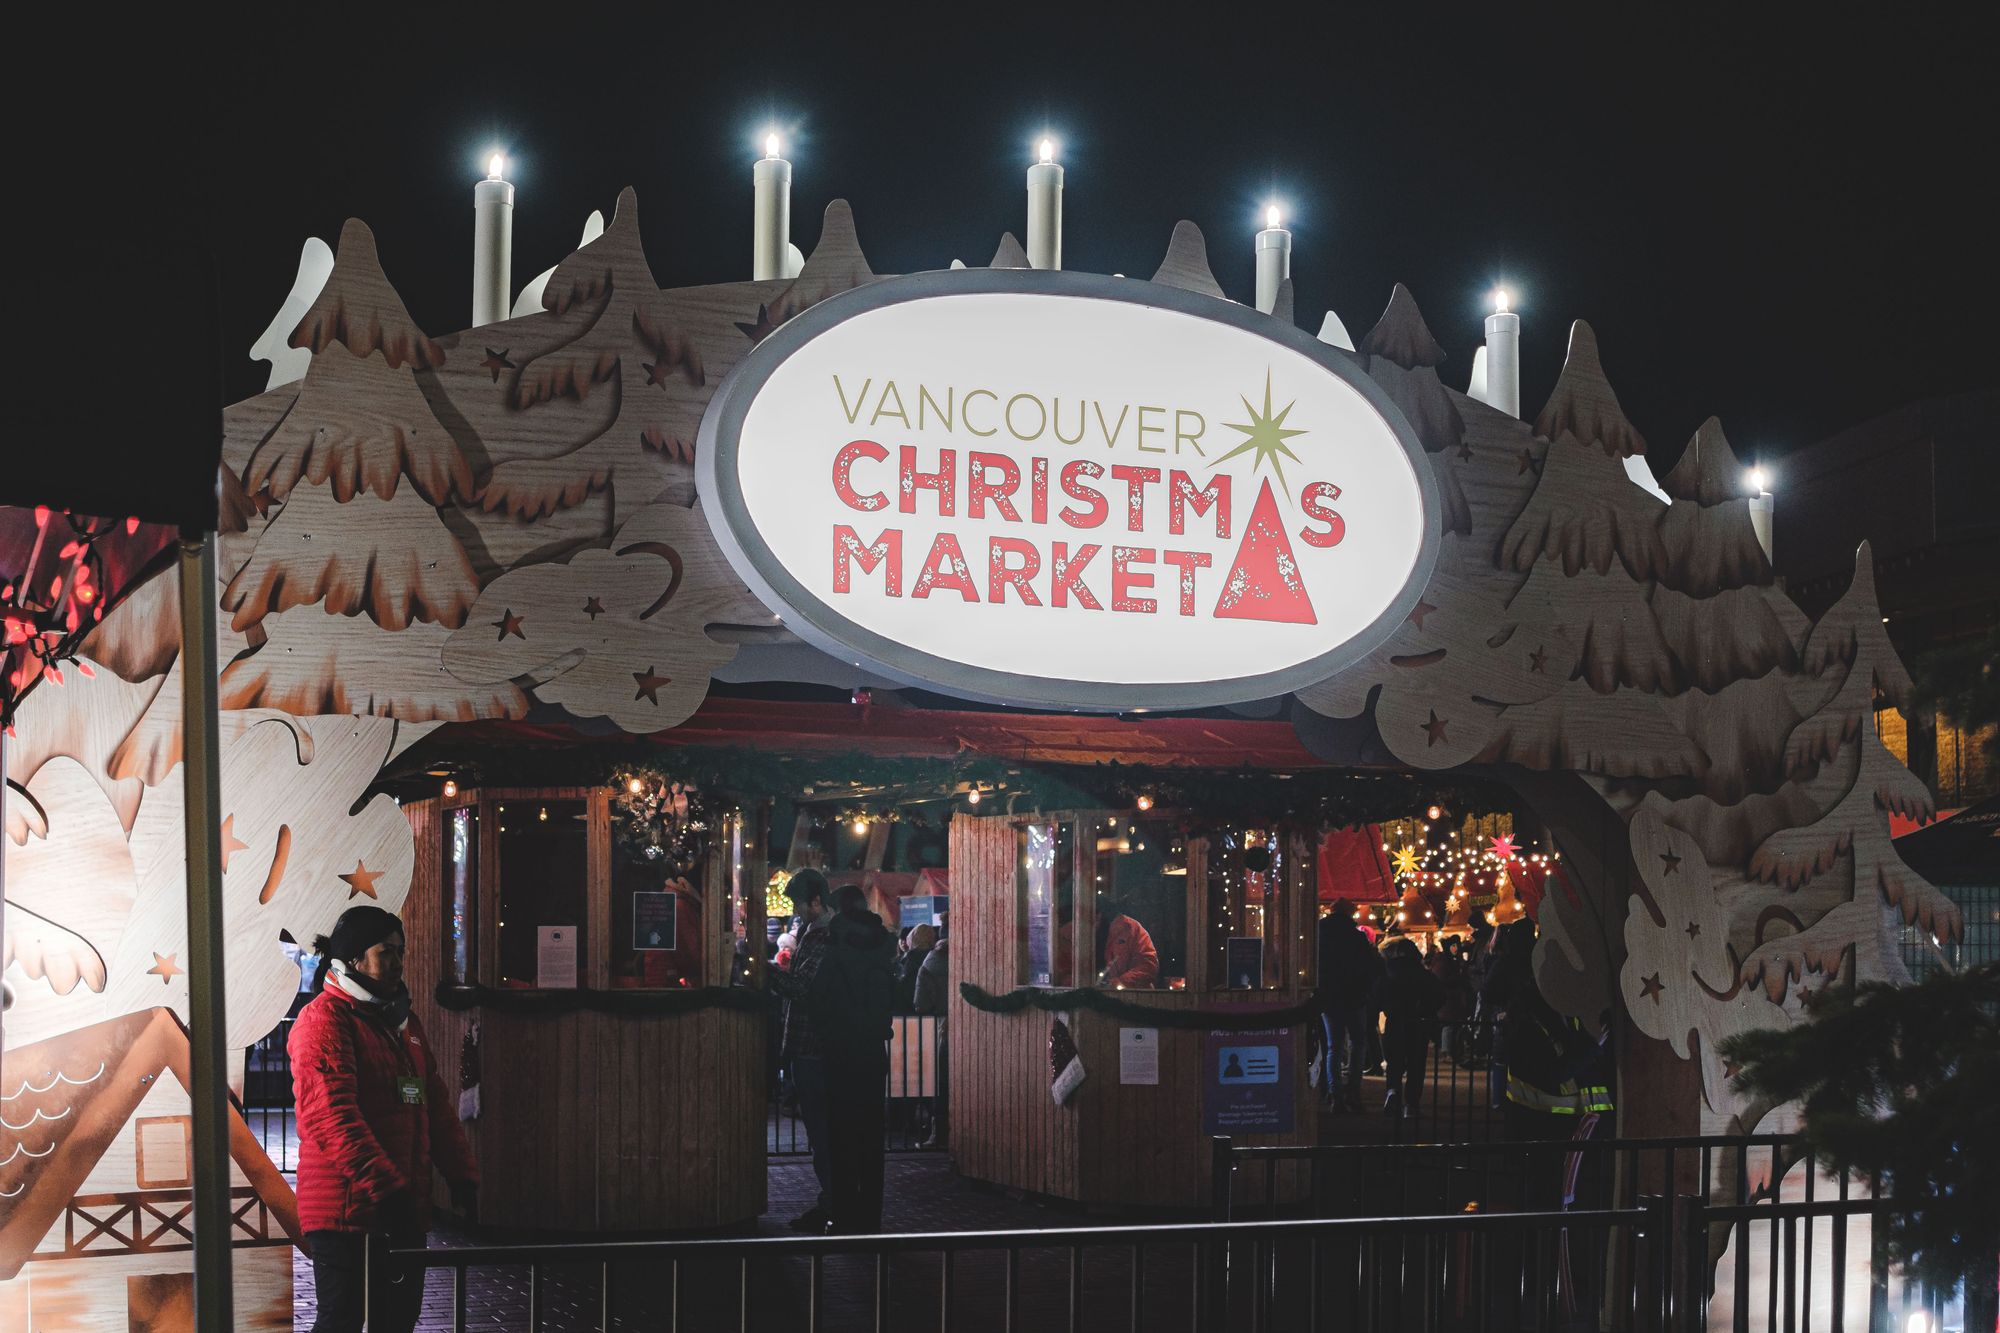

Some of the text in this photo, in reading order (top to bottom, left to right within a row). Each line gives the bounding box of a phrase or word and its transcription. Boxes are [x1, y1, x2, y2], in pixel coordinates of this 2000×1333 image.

[833, 375, 1206, 457] VANCOUVER
[832, 440, 1346, 625] CHRISTMAS
[833, 525, 1213, 617] MARKET
